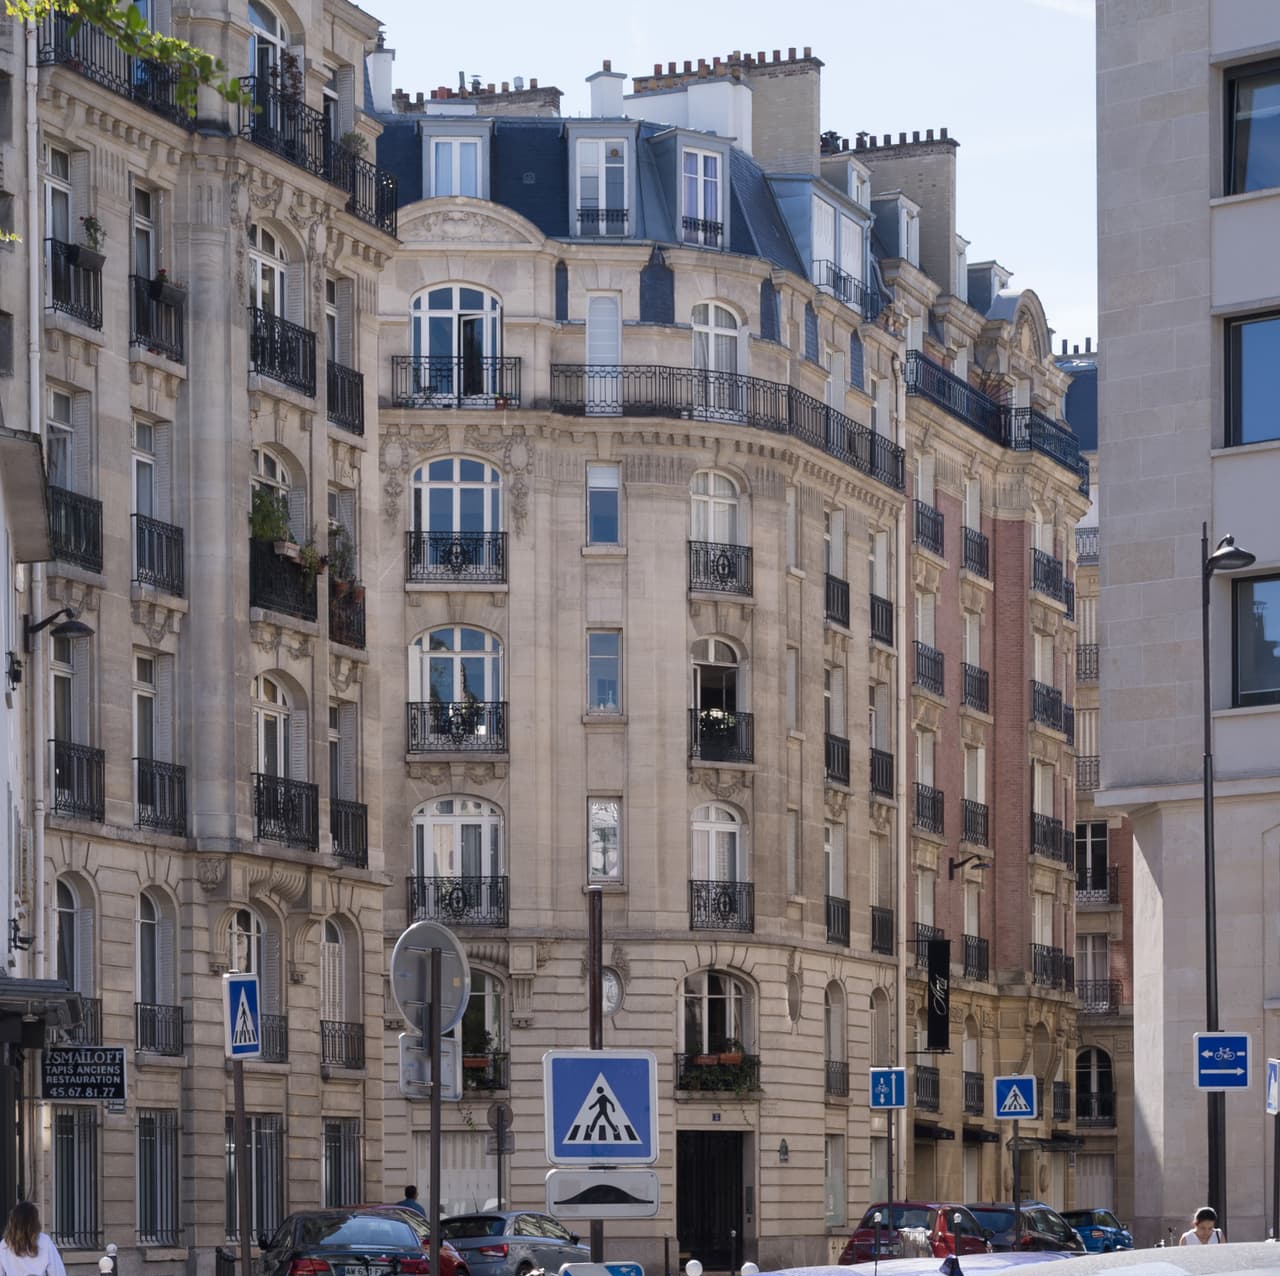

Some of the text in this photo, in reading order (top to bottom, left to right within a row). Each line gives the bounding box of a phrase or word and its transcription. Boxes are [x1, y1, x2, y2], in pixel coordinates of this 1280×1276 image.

[46, 1049, 123, 1065] ISMAÏLOFF
[46, 1066, 120, 1074] TAPIS ANCIENS
[46, 1076, 120, 1084] RESTAURATION
[50, 1087, 115, 1097] 45.67.81.77
